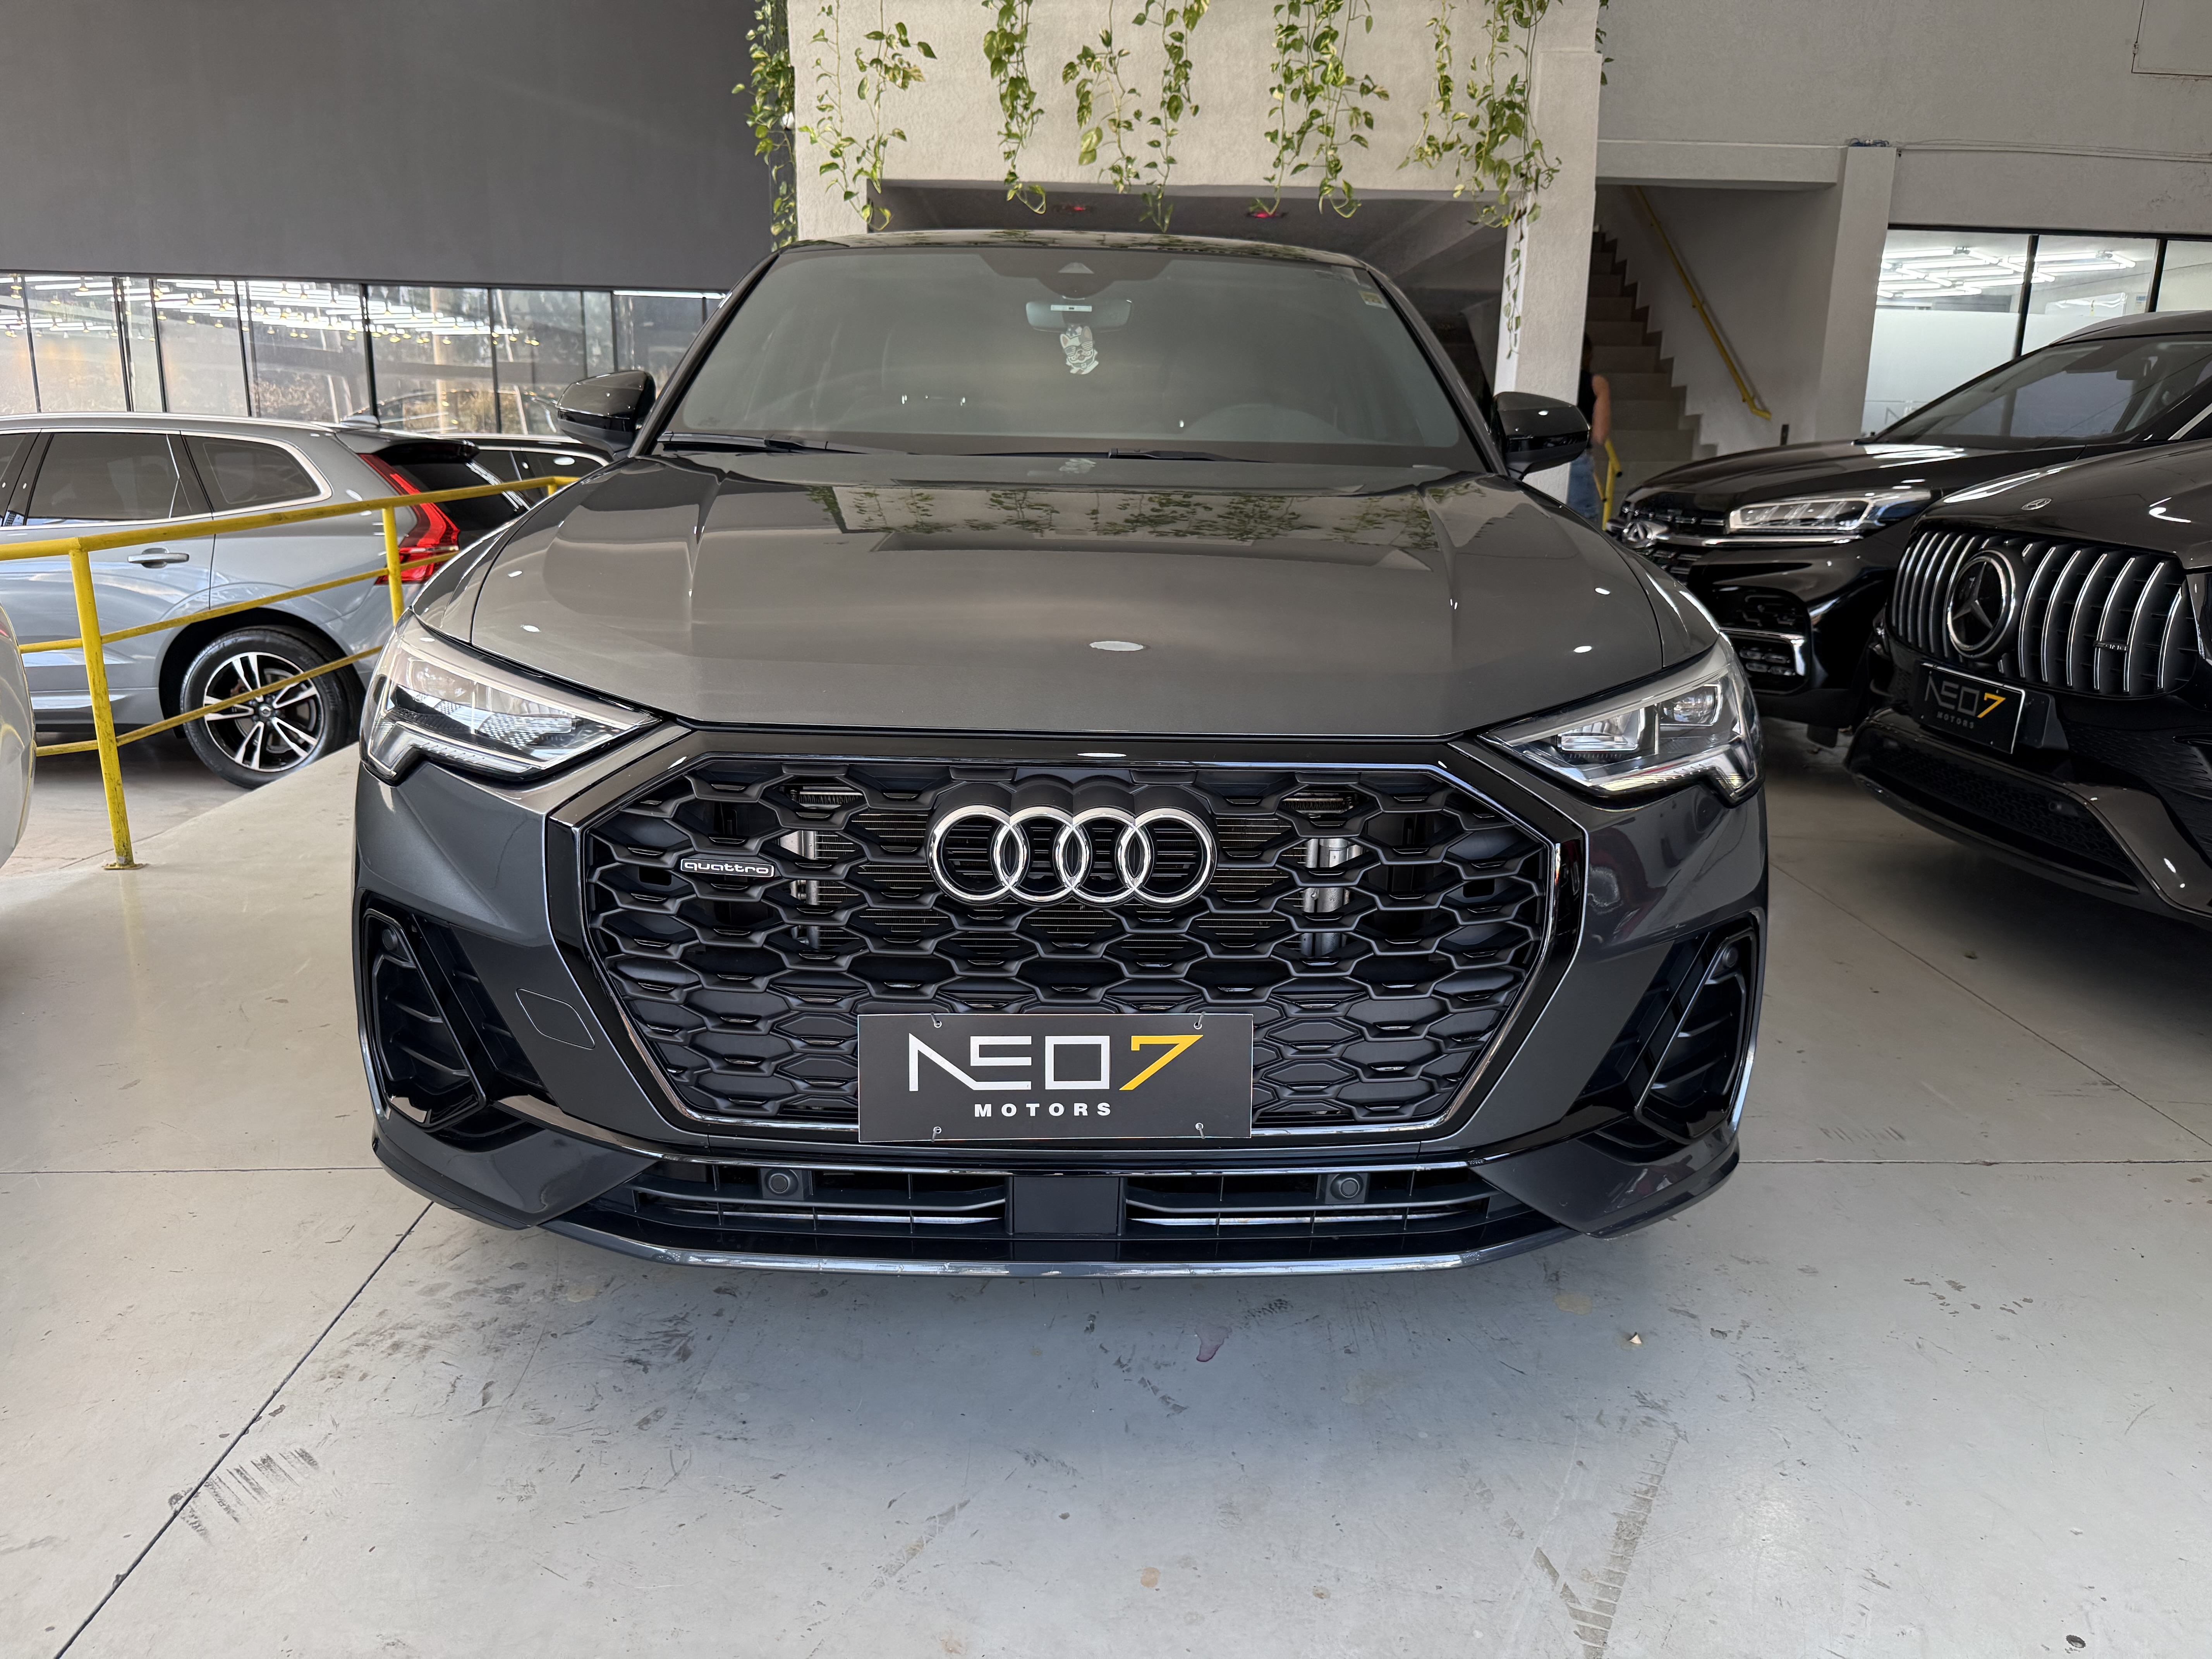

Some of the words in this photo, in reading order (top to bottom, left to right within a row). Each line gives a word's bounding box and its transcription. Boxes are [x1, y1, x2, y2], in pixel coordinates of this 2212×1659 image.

[1924, 675, 2006, 718] NEO7
[1937, 711, 1974, 729] MOTORS
[684, 862, 769, 874] quattro
[909, 1033, 1203, 1091] NEO7
[975, 1102, 1111, 1117] MOTORS
